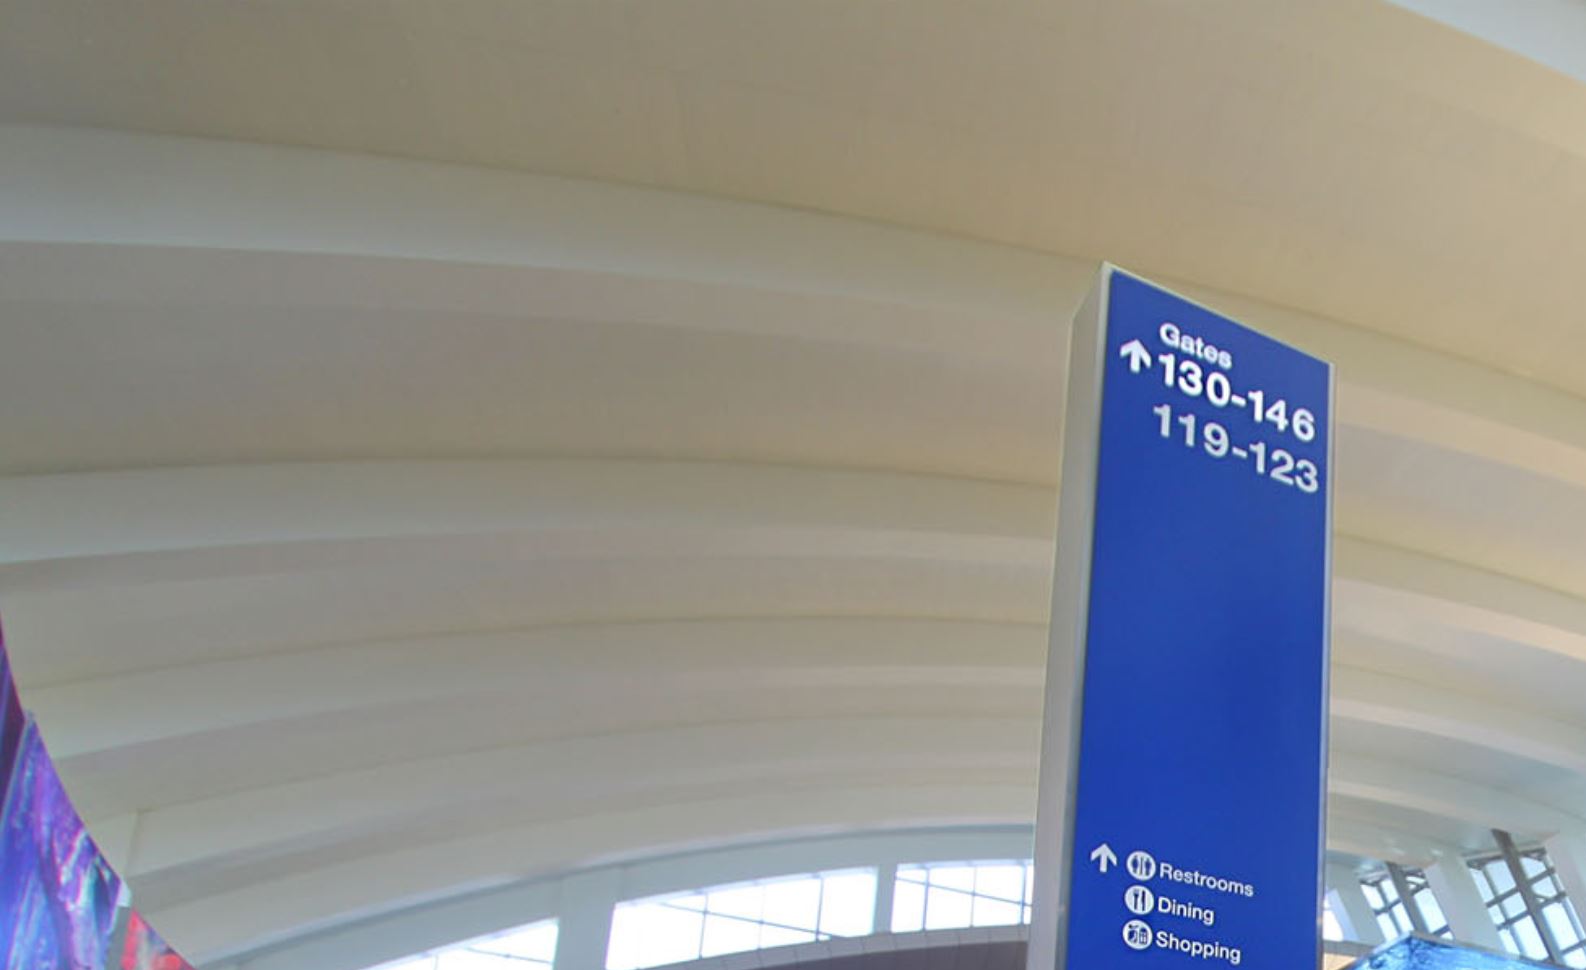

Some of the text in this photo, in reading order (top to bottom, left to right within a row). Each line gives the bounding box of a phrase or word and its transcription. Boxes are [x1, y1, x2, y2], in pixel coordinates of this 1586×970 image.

[1159, 323, 1232, 369] Gates
[1158, 353, 1315, 441] 130-146
[1153, 403, 1318, 492] 119-123
[1159, 863, 1254, 896] Restrooms
[1158, 896, 1215, 926] Dining
[1156, 931, 1241, 965] Shopping
